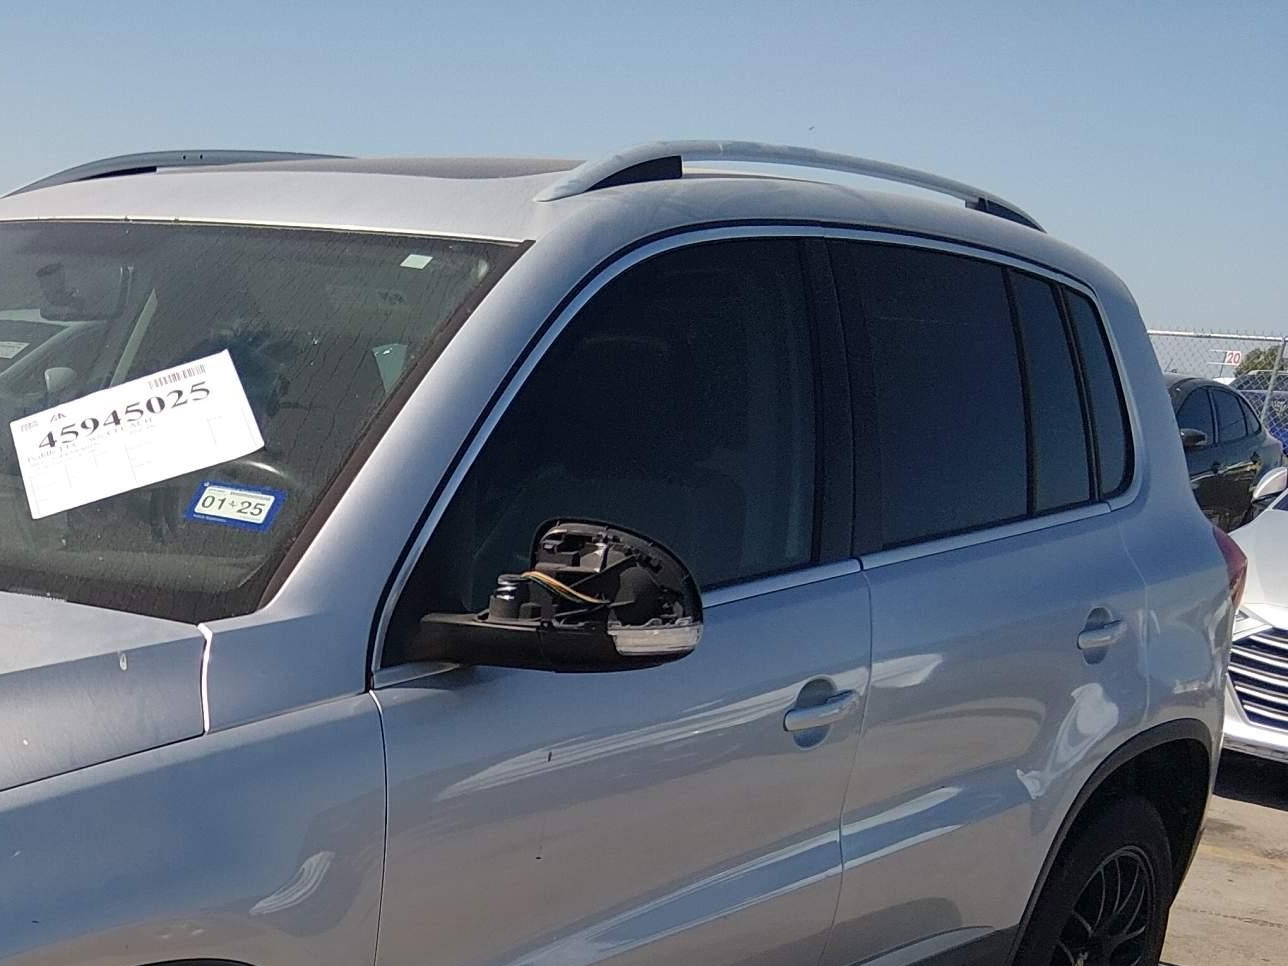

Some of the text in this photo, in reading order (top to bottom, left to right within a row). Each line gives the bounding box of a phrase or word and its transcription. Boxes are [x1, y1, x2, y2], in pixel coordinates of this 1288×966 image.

[1226, 352, 1241, 364] 20
[39, 381, 210, 448] 45945025
[201, 495, 266, 517] 01 25
